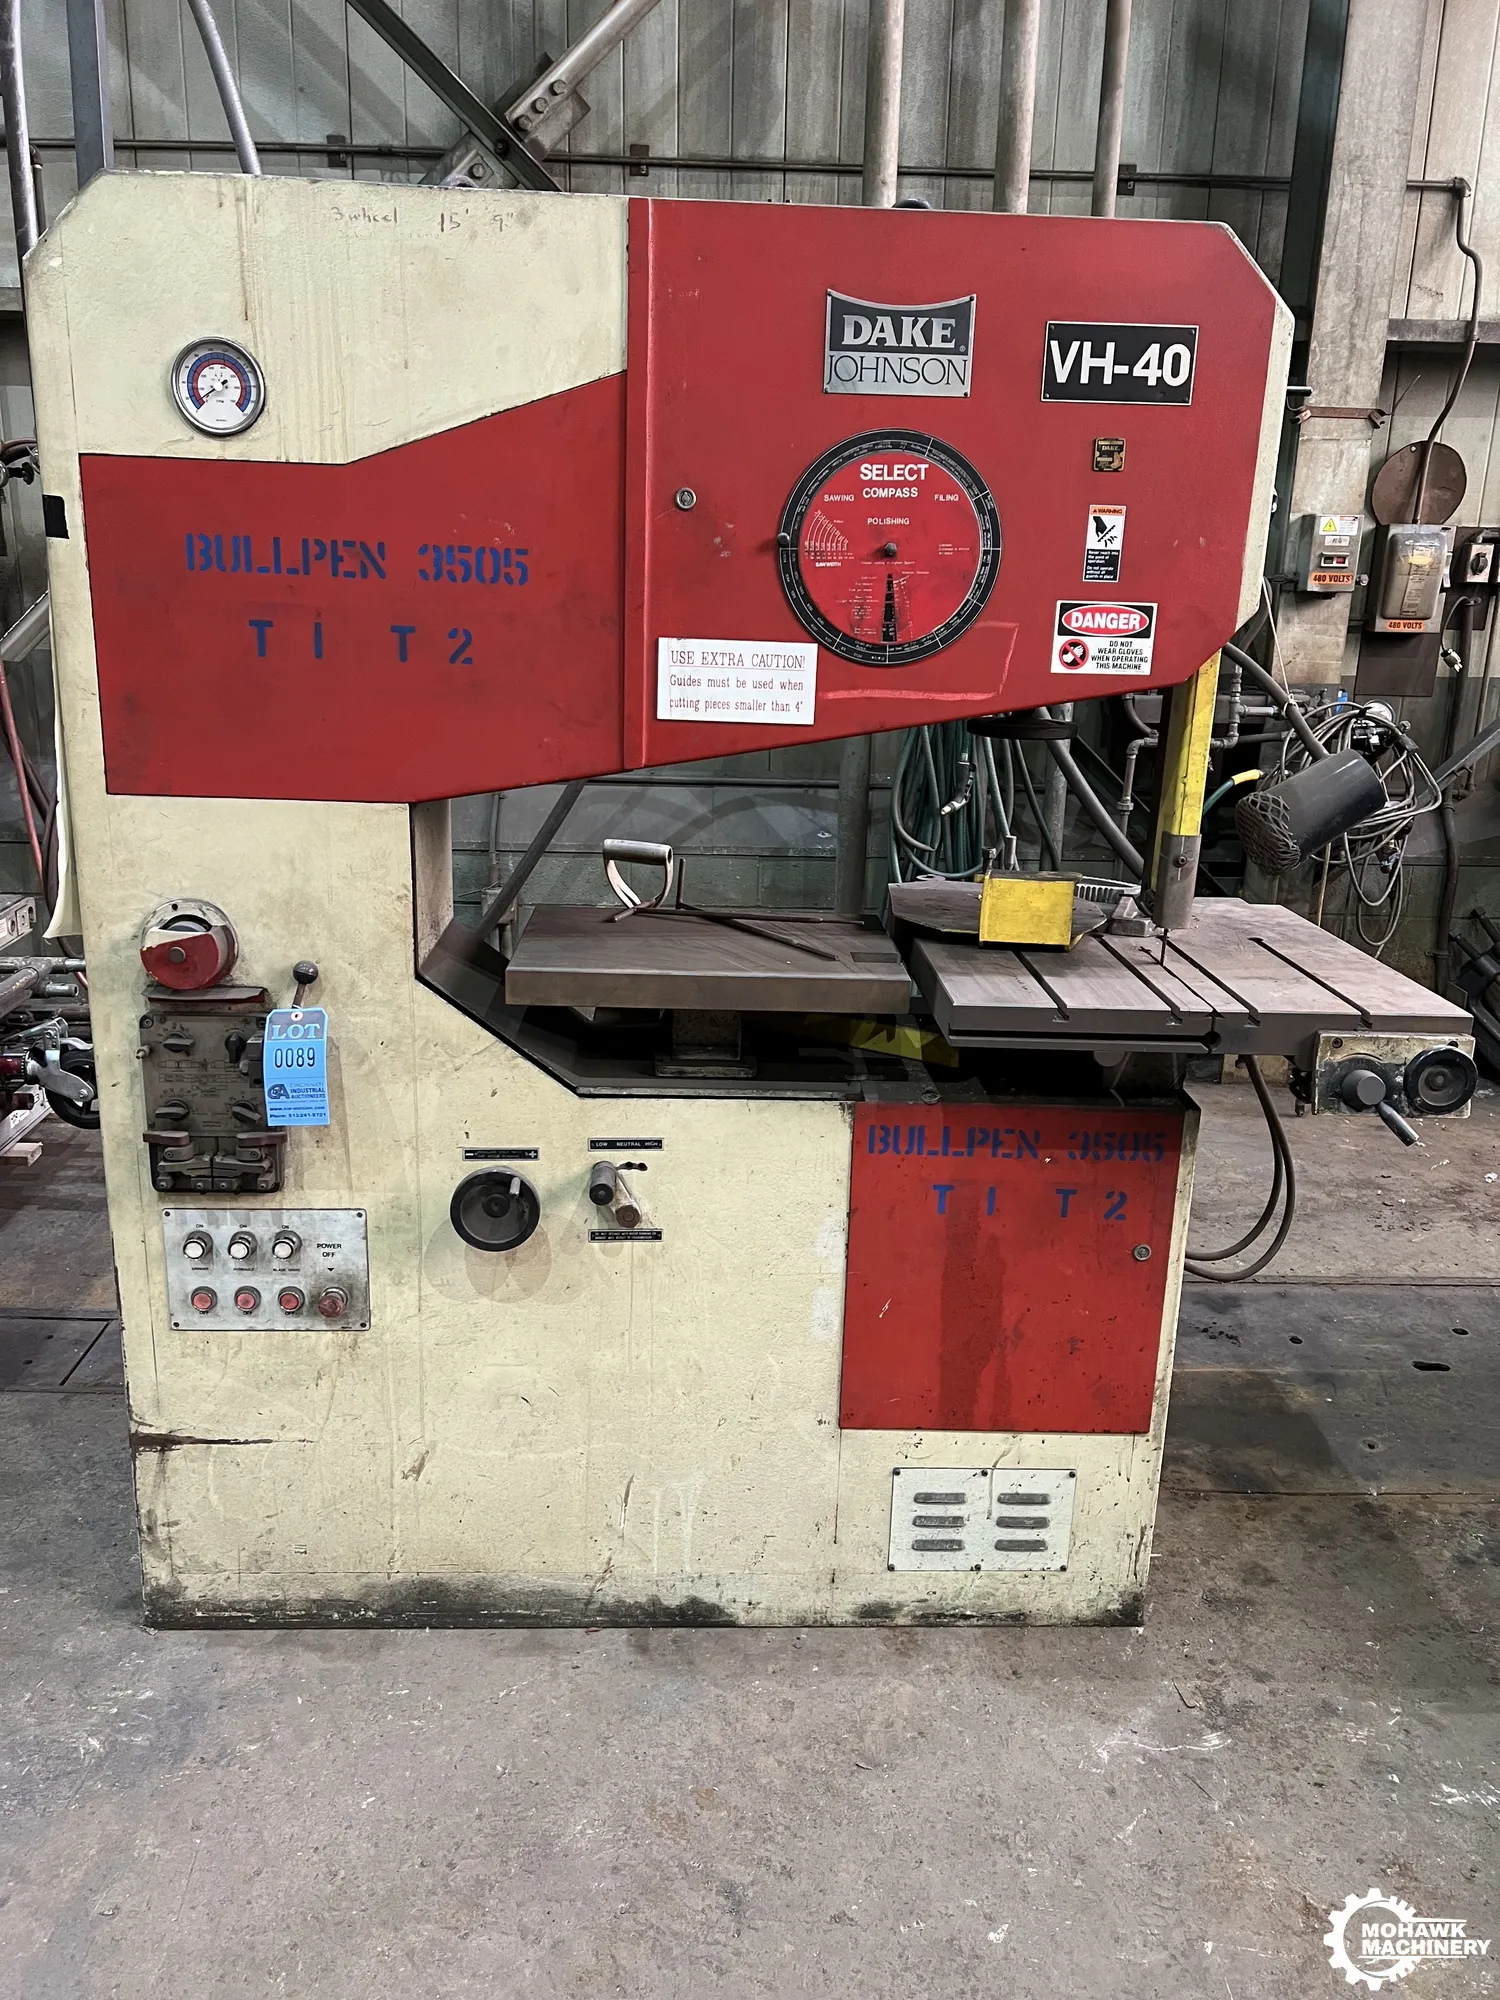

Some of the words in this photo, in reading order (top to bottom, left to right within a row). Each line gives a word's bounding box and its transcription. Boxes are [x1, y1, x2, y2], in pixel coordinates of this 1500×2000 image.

[842, 315, 956, 348] DAKE
[826, 354, 968, 386] JOHNSON
[1050, 340, 1191, 387] VH-40
[860, 463, 929, 481] SELECT
[824, 494, 854, 502] SAWING
[862, 487, 918, 498] COMPASS
[934, 494, 959, 502] FILING
[867, 517, 910, 525] POLISHING
[186, 533, 386, 579] BULLPEN
[418, 544, 528, 585] 3505
[1313, 574, 1326, 582] 480
[1328, 574, 1351, 583] VOLTS
[1070, 611, 1140, 630] DANGER
[1402, 622, 1423, 630] VOLTS
[249, 620, 274, 657] T
[391, 625, 416, 662] T
[448, 628, 473, 664] 2
[670, 650, 695, 665] USE
[701, 651, 745, 667] EXTRA
[751, 653, 806, 669] CAUTION!
[1118, 648, 1143, 656] GLOVES
[670, 674, 702, 687] Guides
[707, 676, 730, 688] must
[736, 677, 747, 688] be
[752, 678, 774, 690] used
[780, 679, 804, 691] when
[670, 698, 700, 712] cutting
[704, 698, 731, 713] pieces
[735, 700, 767, 711] smaller
[771, 700, 790, 712] than
[272, 1024, 320, 1040] LOT
[274, 1047, 316, 1068] 0089
[868, 1124, 1041, 1159] BULLPEN
[1068, 1130, 1168, 1162] 3505
[932, 1184, 954, 1214] T
[1056, 1188, 1078, 1218] T
[1104, 1190, 1128, 1220] 2
